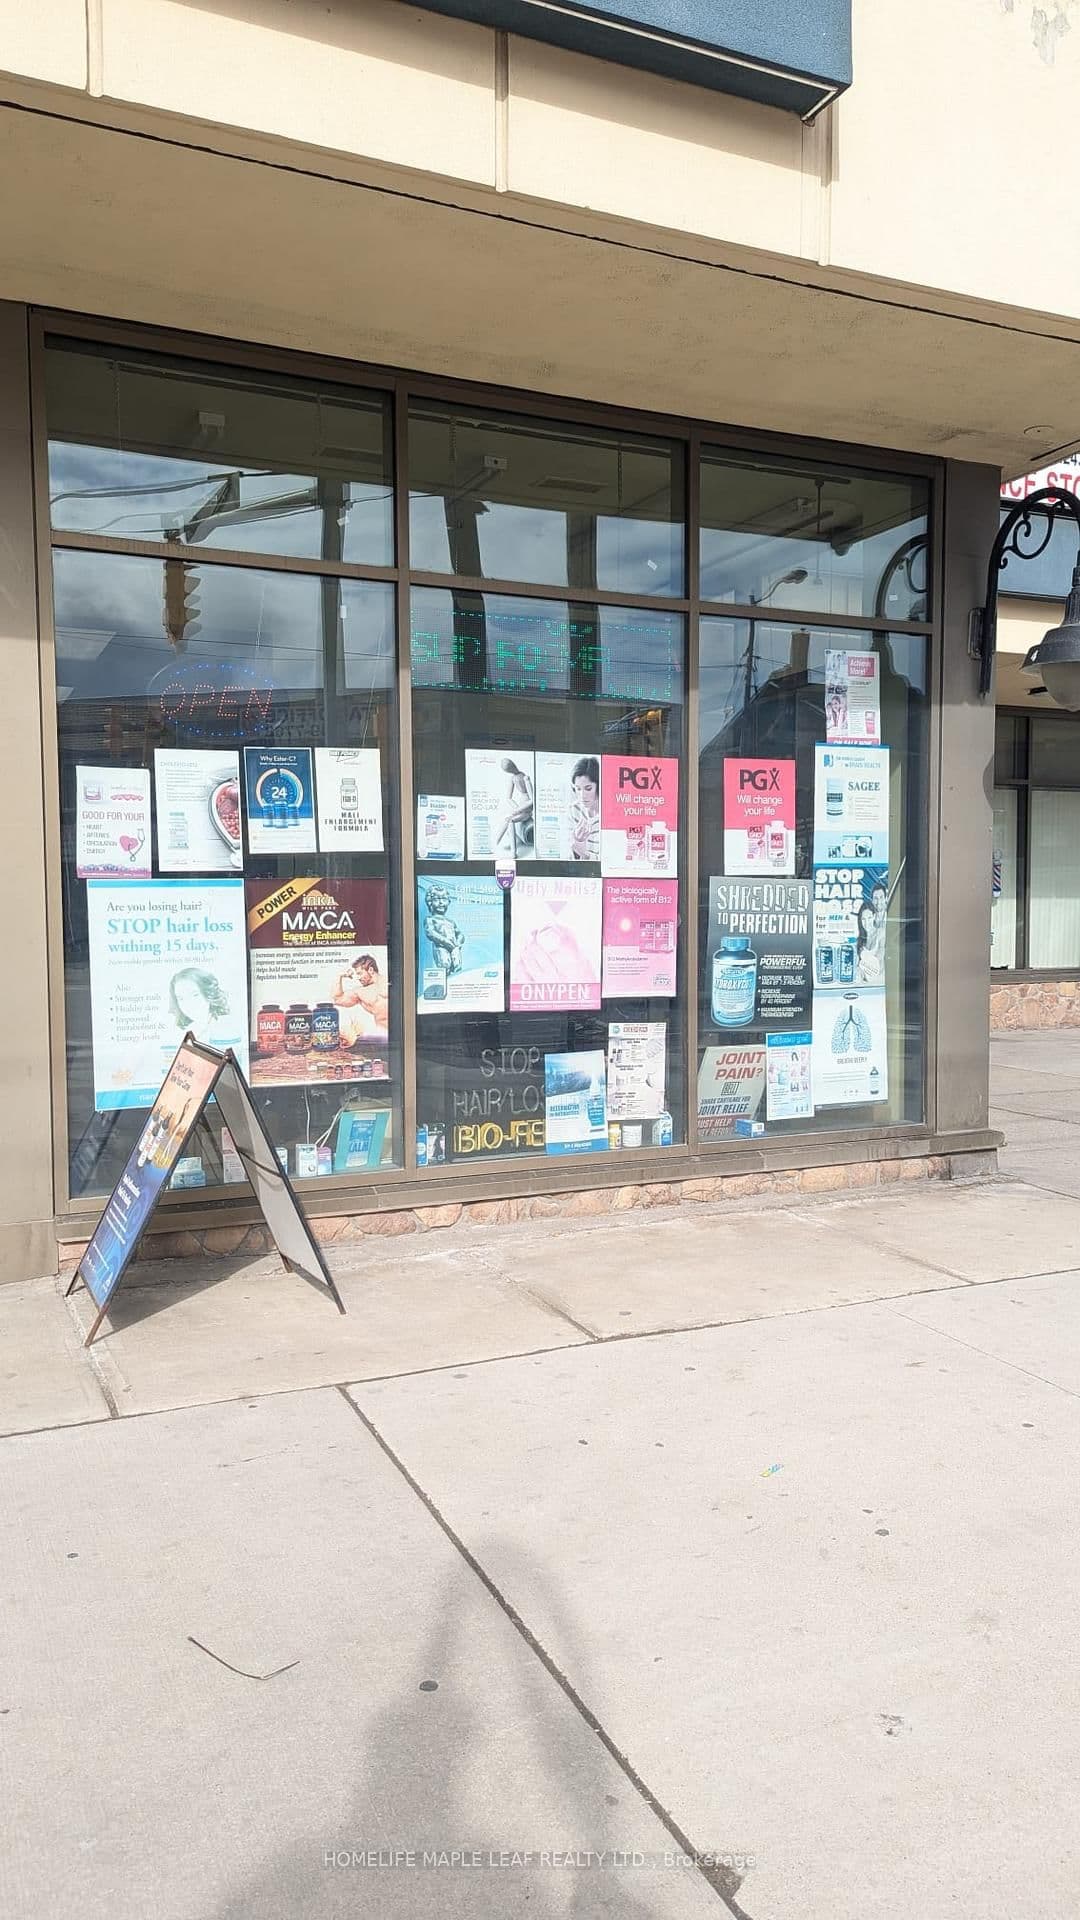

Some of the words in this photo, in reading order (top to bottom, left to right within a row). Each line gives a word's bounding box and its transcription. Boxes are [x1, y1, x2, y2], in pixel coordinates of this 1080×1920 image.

[161, 683, 273, 715] OPEN
[618, 766, 662, 790] PGX
[739, 767, 780, 791] PGX
[271, 786, 287, 799] 24
[847, 781, 880, 791] SAGEE
[616, 793, 632, 804] Will
[633, 794, 665, 806] change
[737, 794, 752, 804] Will
[752, 795, 783, 806] change
[82, 811, 105, 820] GOOD
[107, 811, 122, 821] FOR
[123, 812, 145, 822] YOUR
[623, 807, 643, 816] your
[644, 806, 657, 816] life
[744, 807, 761, 816] your
[763, 806, 775, 816] life
[815, 868, 864, 884] STOP
[607, 886, 620, 894] The
[621, 886, 659, 896] biologically
[717, 884, 809, 912] SHREDDED
[815, 883, 864, 899] HAIR
[107, 901, 125, 912] Are
[127, 904, 146, 913] you
[148, 899, 178, 914] losing
[180, 899, 202, 911] hair?
[256, 886, 297, 919] POWER
[610, 896, 632, 904] active
[633, 896, 650, 904] form
[650, 895, 657, 904] of
[658, 896, 672, 904] B12
[107, 917, 161, 935] STOP
[166, 917, 200, 933] hair
[203, 916, 234, 933] loss
[282, 911, 355, 931] MACA
[717, 912, 728, 925] TO
[729, 913, 808, 934] PERFECTION
[282, 931, 314, 942] Energy
[315, 930, 357, 940] Enhancer
[108, 939, 162, 956] withing
[166, 939, 182, 952] 15
[185, 937, 220, 955] days.
[760, 957, 807, 966] POWERFUL
[521, 983, 591, 1001] ONYPEN
[480, 1047, 541, 1077] STOP
[716, 1051, 766, 1066] JOINT
[715, 1067, 763, 1081] PAIN?
[722, 1103, 749, 1114] RELIEF
